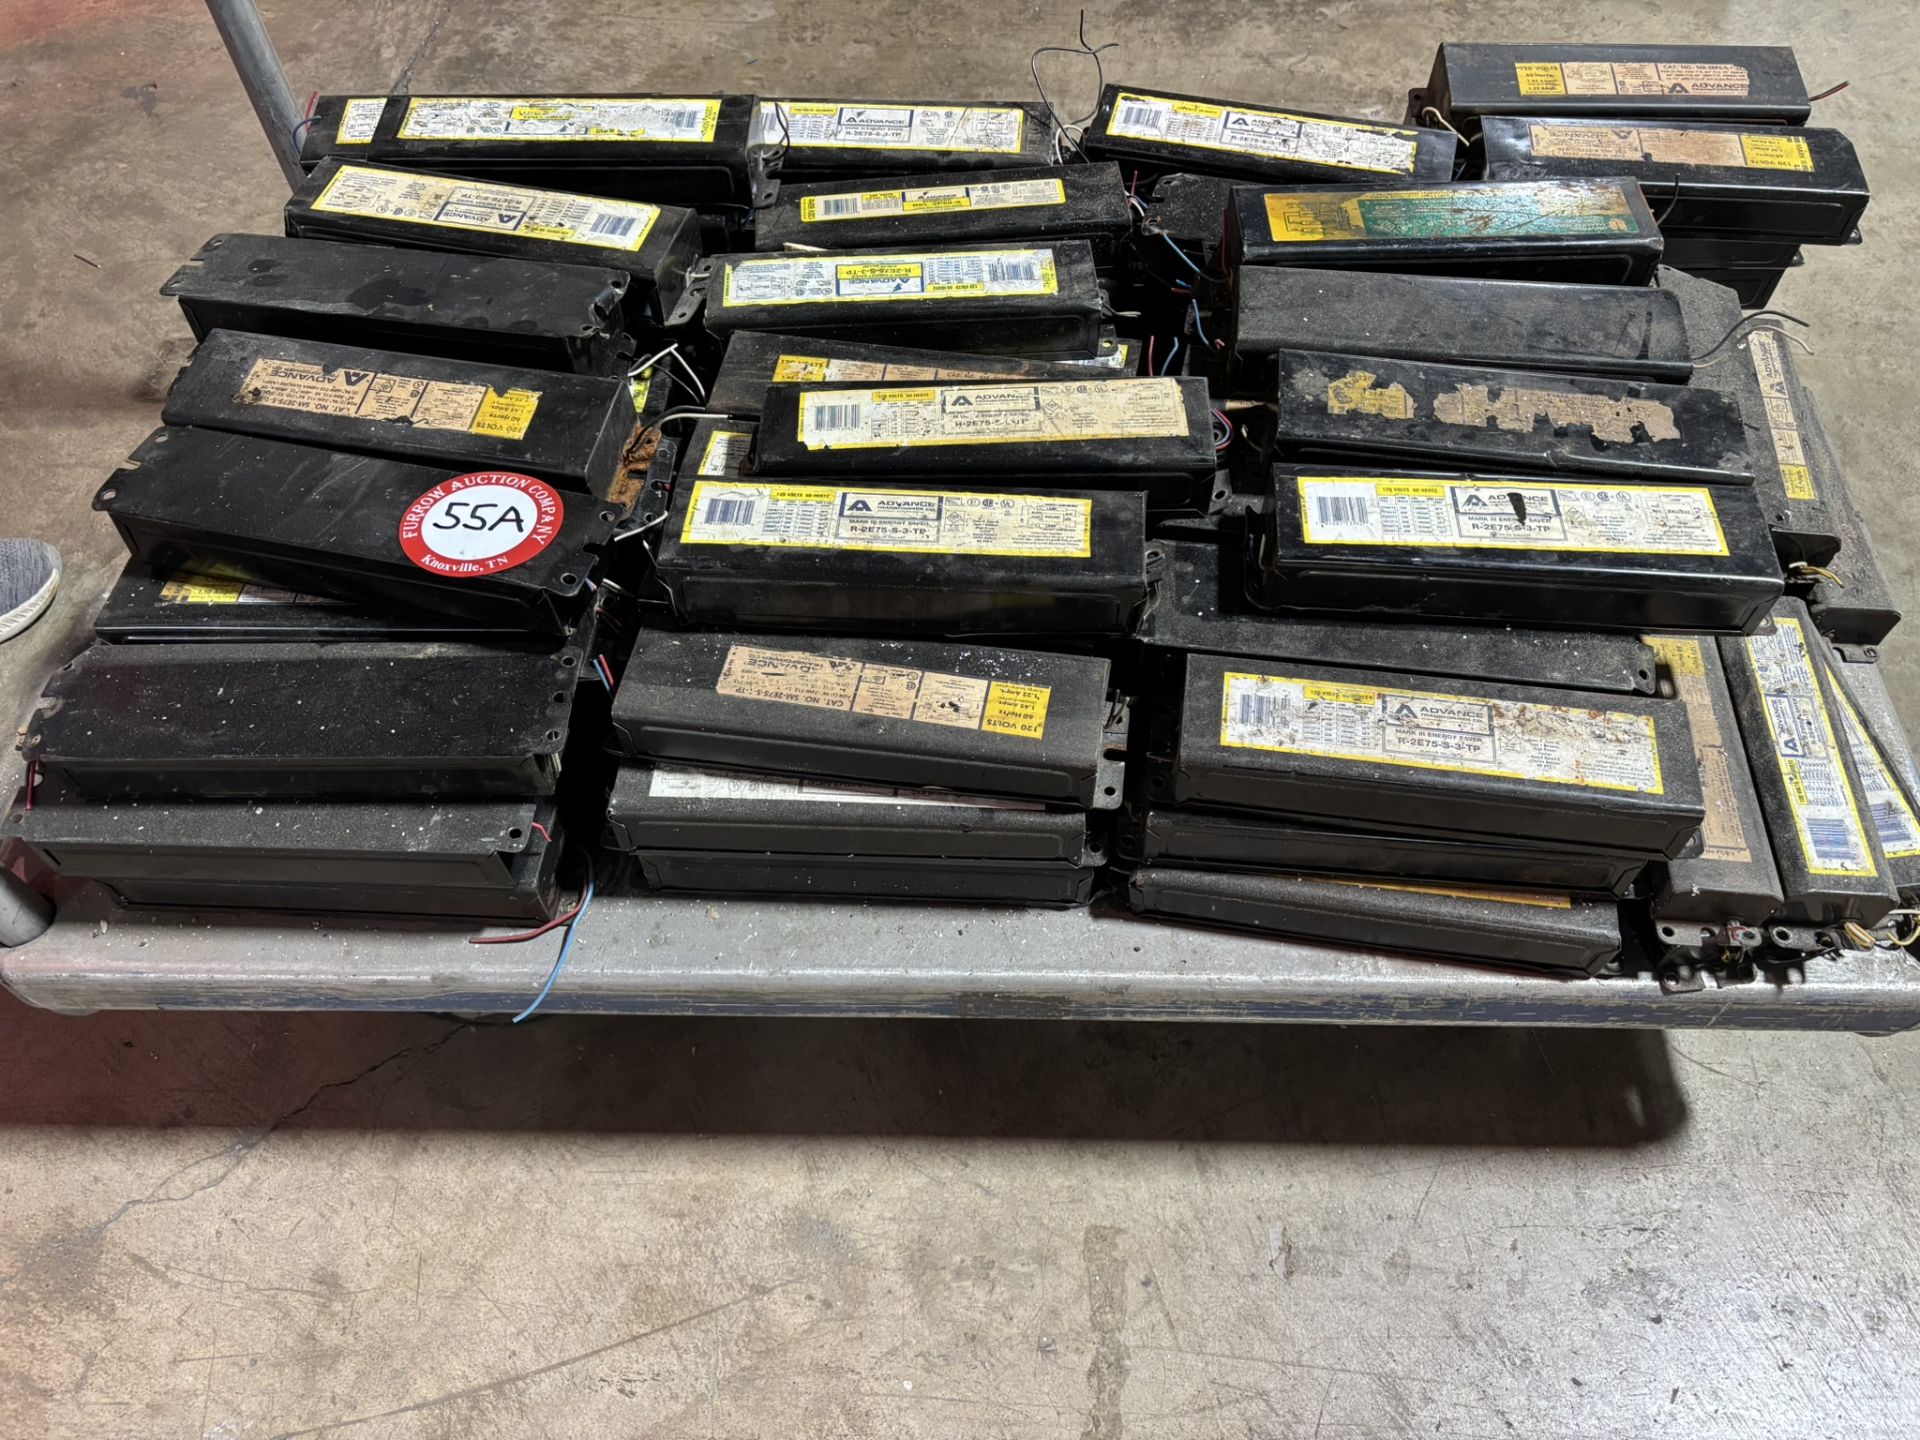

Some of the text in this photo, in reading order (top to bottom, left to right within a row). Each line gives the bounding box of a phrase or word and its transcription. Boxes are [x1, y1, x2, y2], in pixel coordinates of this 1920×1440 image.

[442, 211, 491, 223] ADVANCE
[269, 370, 337, 384] ADVANCE
[315, 403, 329, 411] NO.
[403, 474, 556, 545] FURROW AUCTION COMPANY
[878, 500, 935, 508] ADVANCE
[433, 502, 524, 532] 55A
[850, 526, 926, 534] R-2E75-S-3-TP
[1472, 524, 1550, 532] R-2E75-S-3-TP
[421, 554, 509, 572] Knoxville, TN
[762, 655, 824, 668] TRANSFORMER
[803, 695, 820, 704] NO.
[824, 698, 844, 707] CAT.
[1420, 706, 1484, 718] ADVANCE
[986, 719, 1016, 729] VOLTS
[1427, 732, 1457, 740] ENERGY
[1398, 737, 1481, 752] R-2E75-S-3-TP
